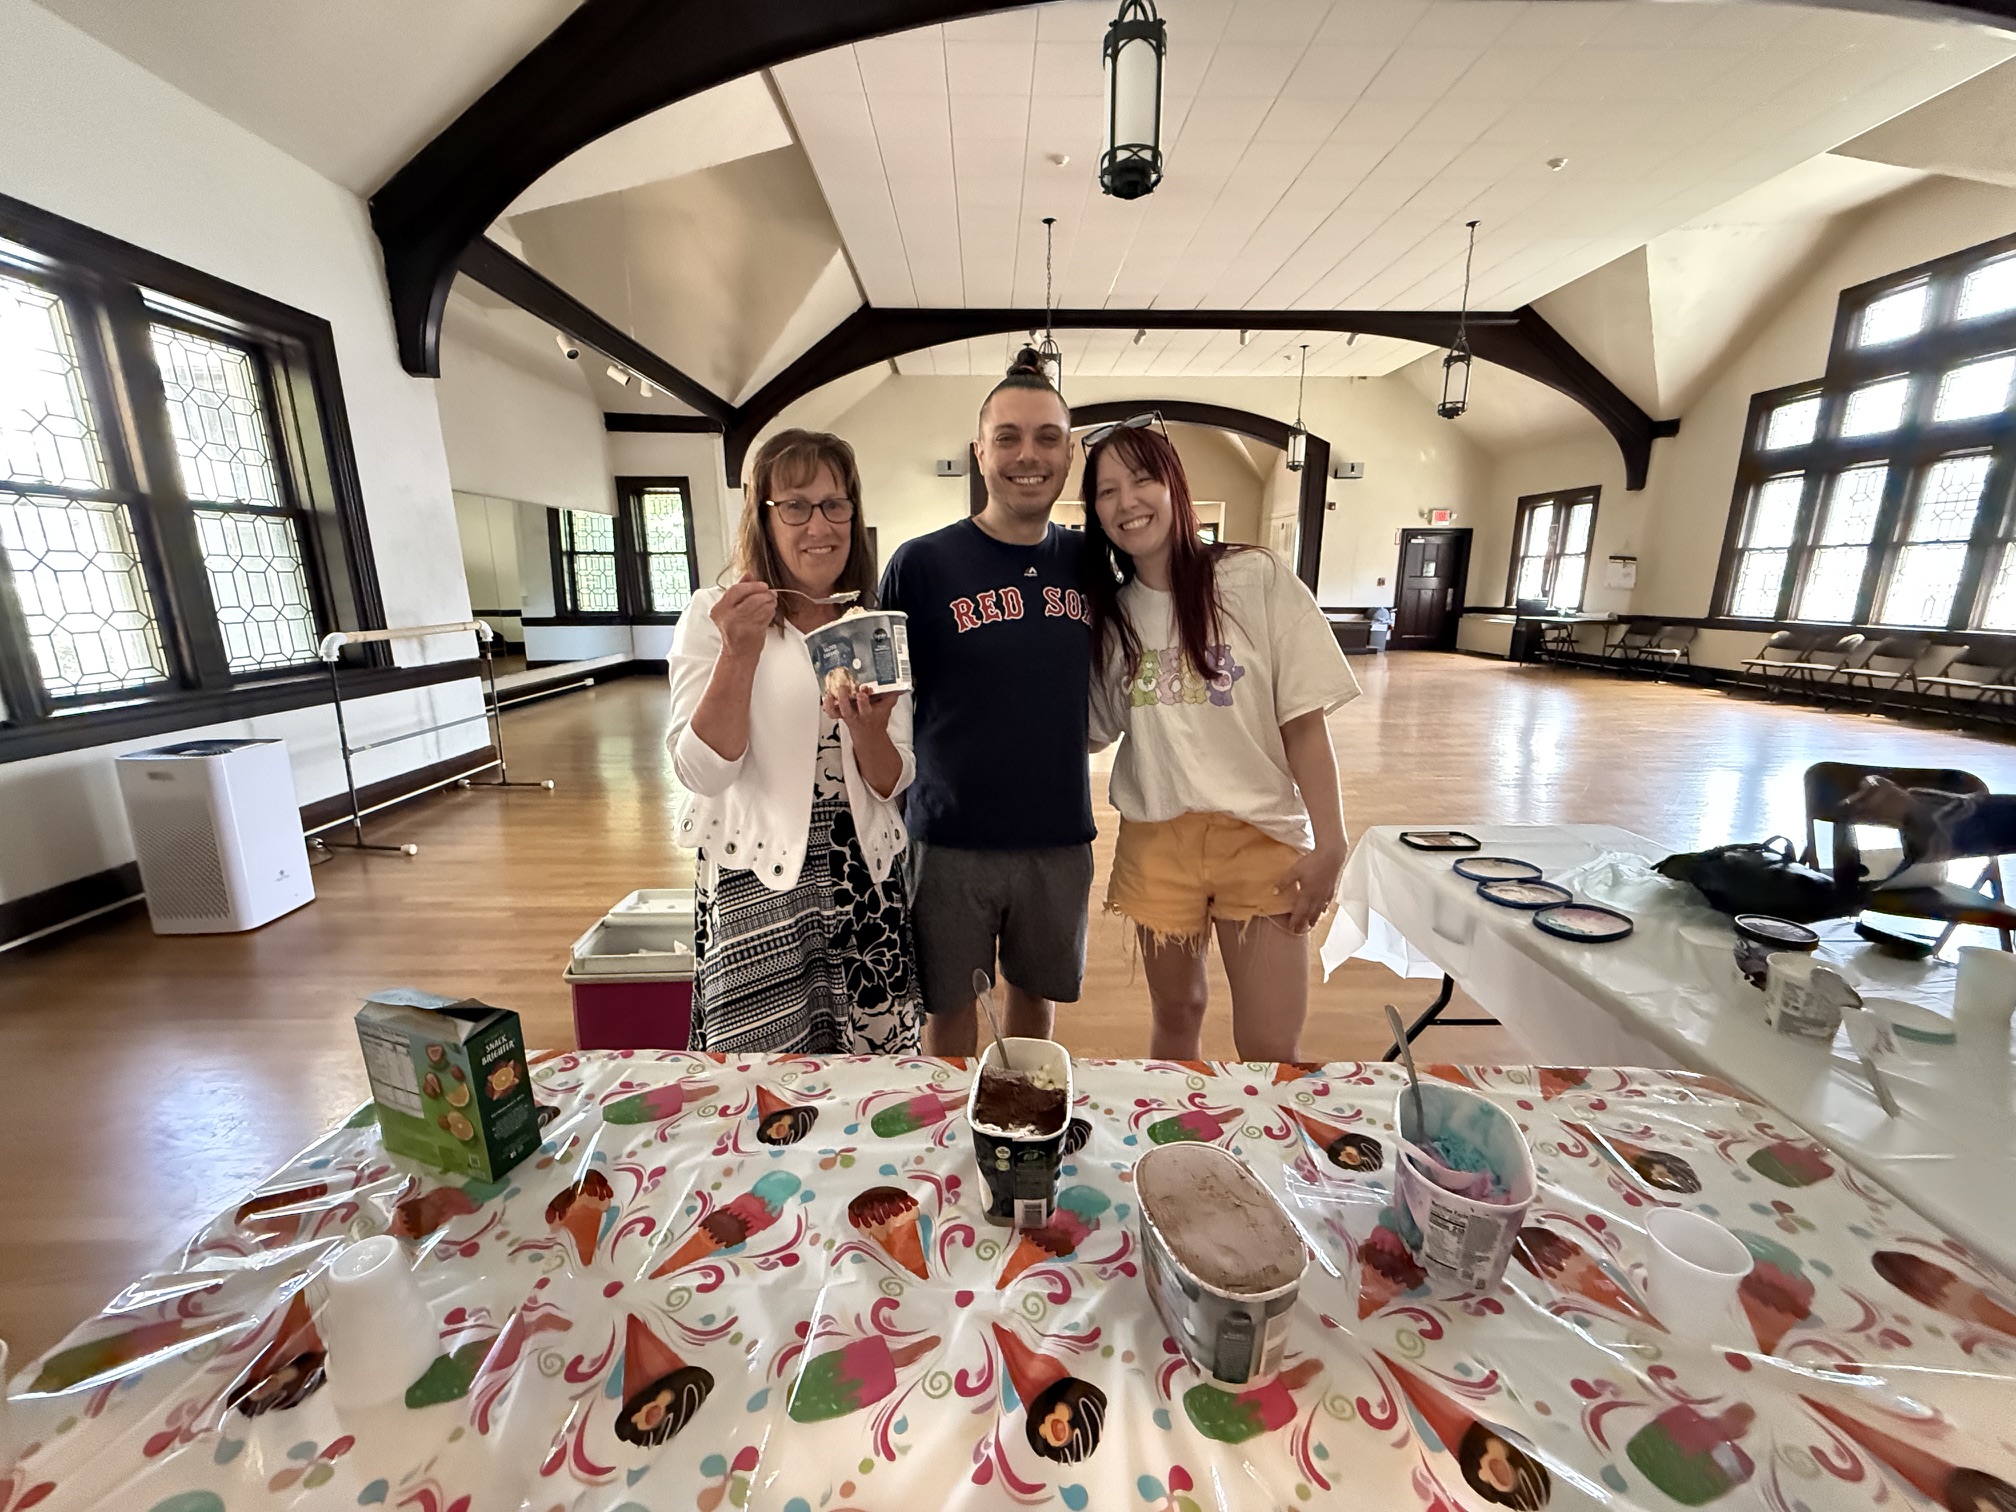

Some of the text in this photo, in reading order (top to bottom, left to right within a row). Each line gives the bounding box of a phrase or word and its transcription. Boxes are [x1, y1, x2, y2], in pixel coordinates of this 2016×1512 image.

[949, 586, 1025, 633] RED
[481, 1040, 515, 1066] BRIGHTER
[485, 1033, 508, 1053] SNACK
